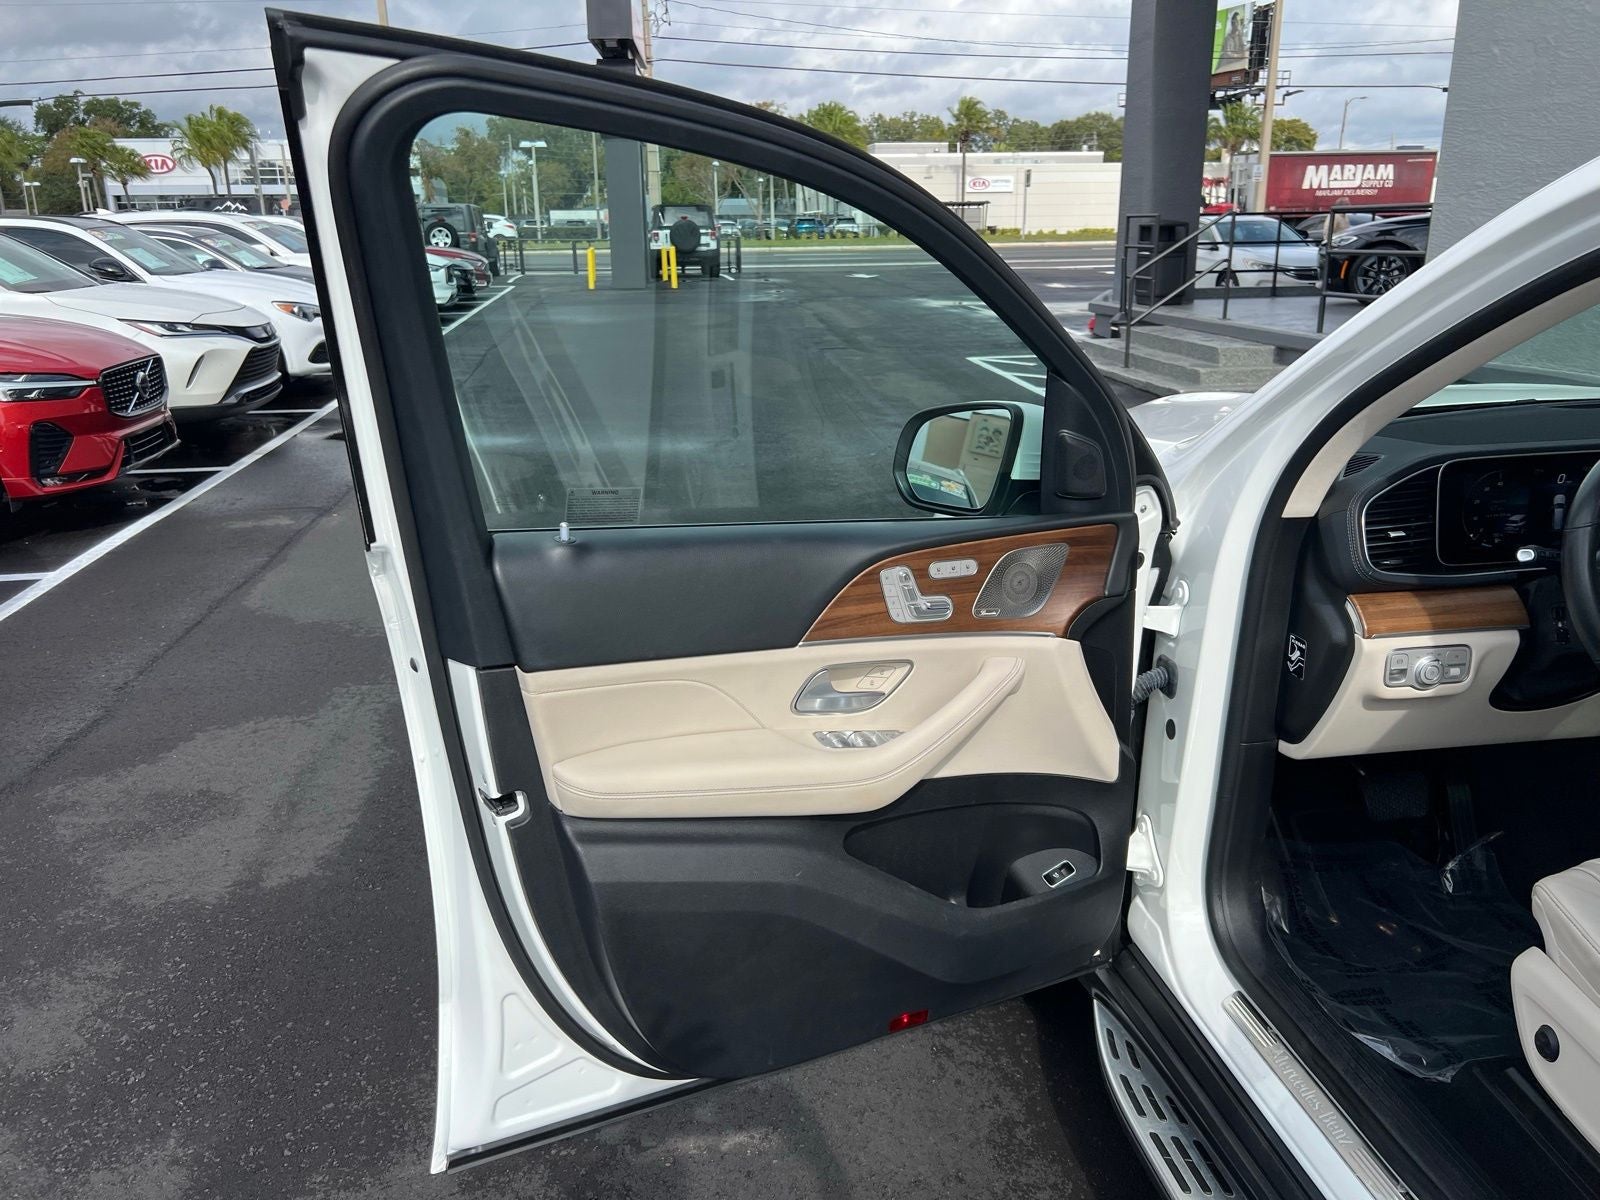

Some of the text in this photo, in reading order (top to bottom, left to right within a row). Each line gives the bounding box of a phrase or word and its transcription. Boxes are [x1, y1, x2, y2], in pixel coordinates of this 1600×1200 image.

[145, 159, 170, 170] KIA
[1301, 164, 1394, 189] MARJAM
[1361, 179, 1384, 188] SUPPLY
[1315, 189, 1343, 197] MARJAM
